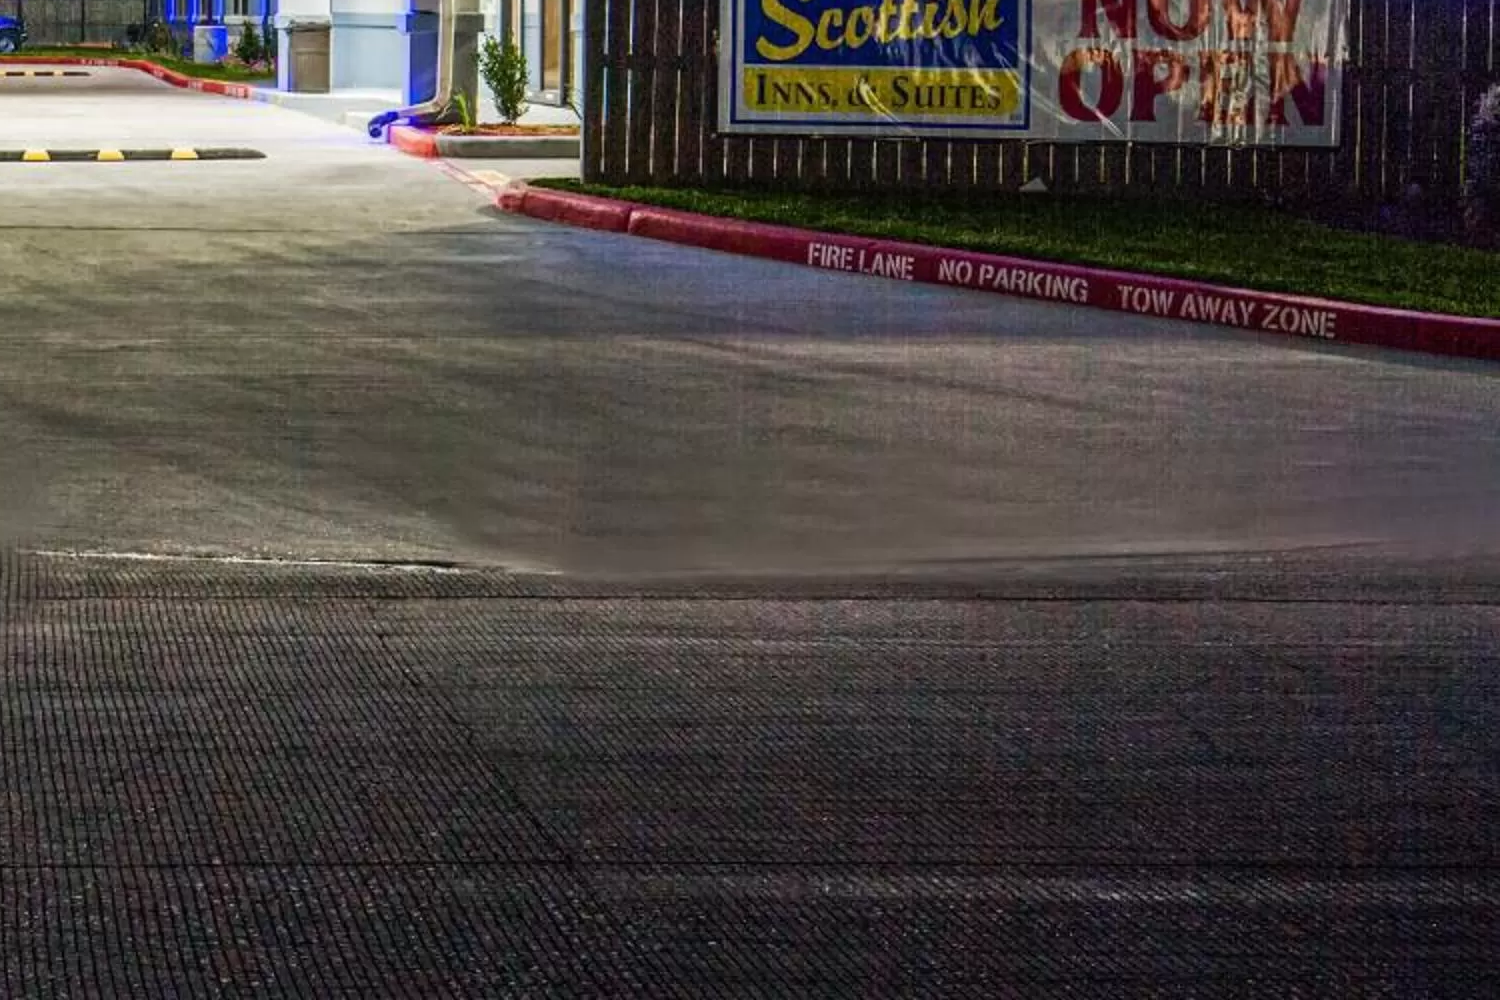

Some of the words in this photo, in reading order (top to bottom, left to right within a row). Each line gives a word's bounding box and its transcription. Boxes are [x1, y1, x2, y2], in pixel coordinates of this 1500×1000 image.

[892, 75, 1001, 111] SUITES
[1058, 46, 1329, 127] OPEN
[807, 242, 854, 271] FIRE
[859, 250, 915, 281] LANE
[938, 257, 973, 284] NO
[978, 263, 1089, 303] PARKING
[1117, 285, 1176, 316] TOW
[1179, 292, 1257, 327] AWAY
[1261, 303, 1338, 339] ZONE
